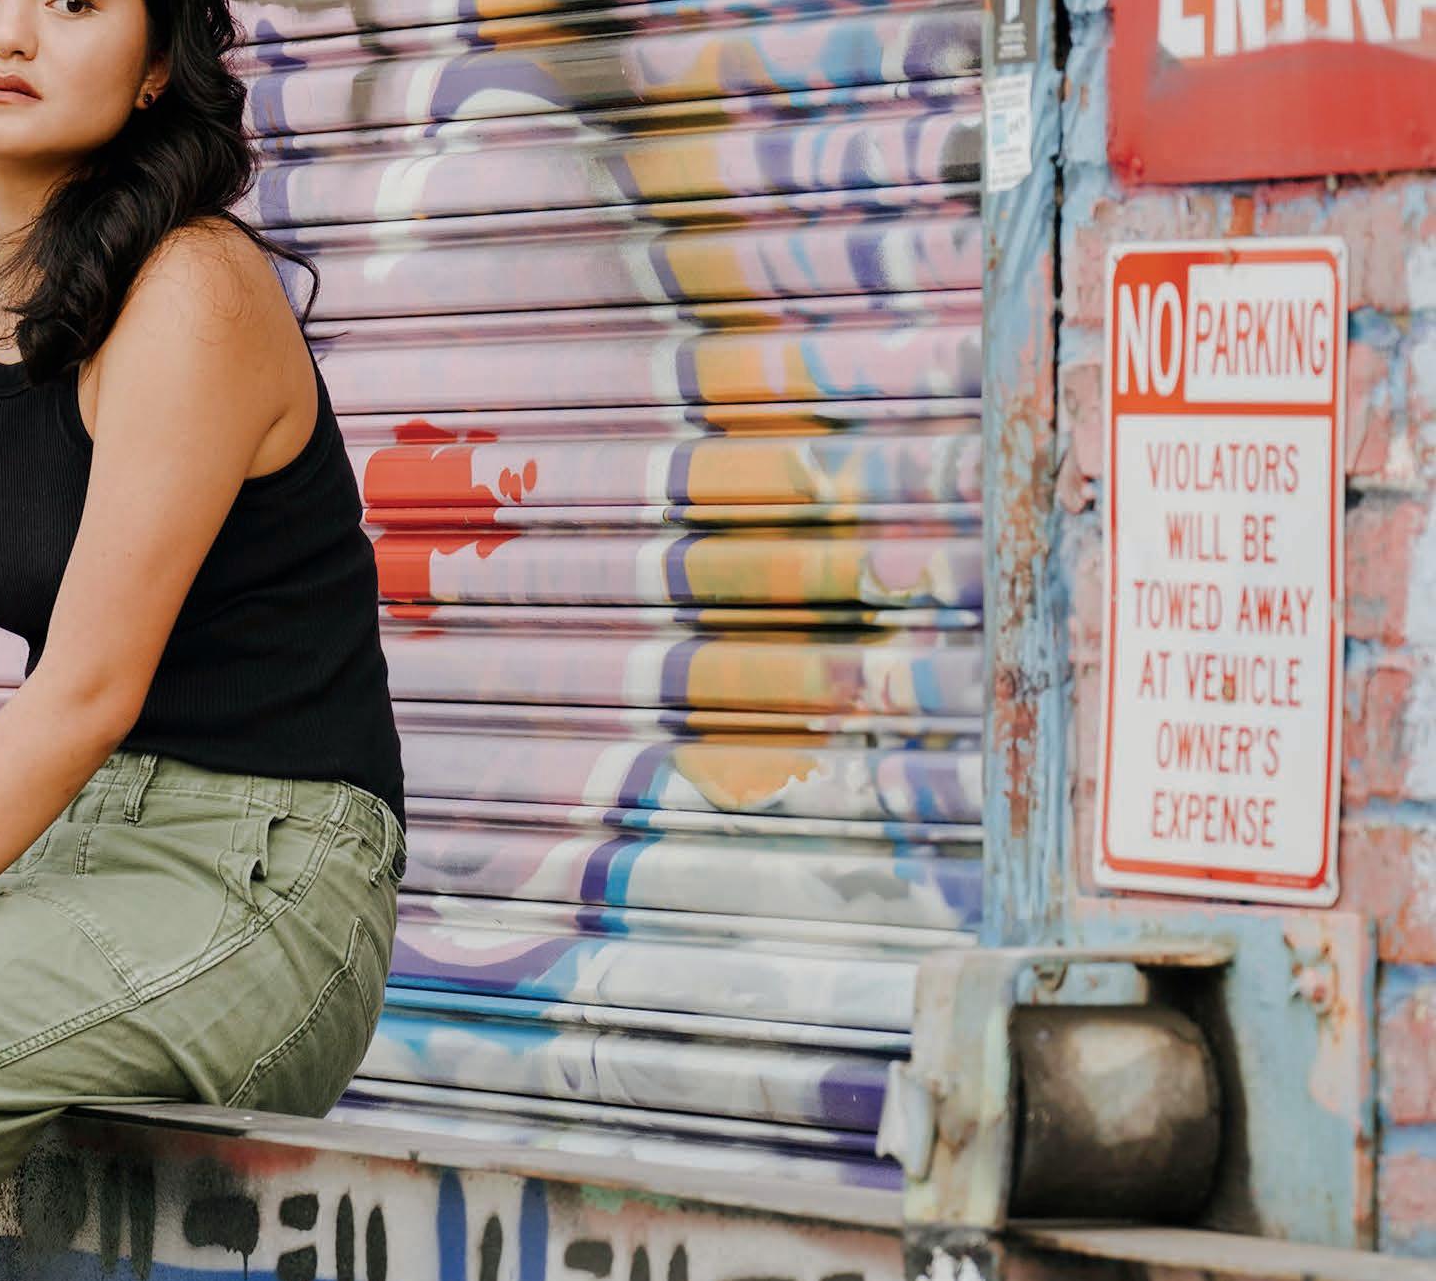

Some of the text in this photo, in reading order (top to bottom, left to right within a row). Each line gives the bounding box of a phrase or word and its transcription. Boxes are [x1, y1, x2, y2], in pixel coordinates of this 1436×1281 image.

[1117, 281, 1328, 397] NO PARKING
[1147, 442, 1300, 493] VIOLATORS
[1166, 512, 1277, 563] WILL BE
[1134, 580, 1314, 636] TOWED AWAY
[1138, 651, 1301, 707] AT VEHICLE
[1156, 721, 1280, 776] OWNER'S
[1151, 791, 1276, 848] EXPENSE
